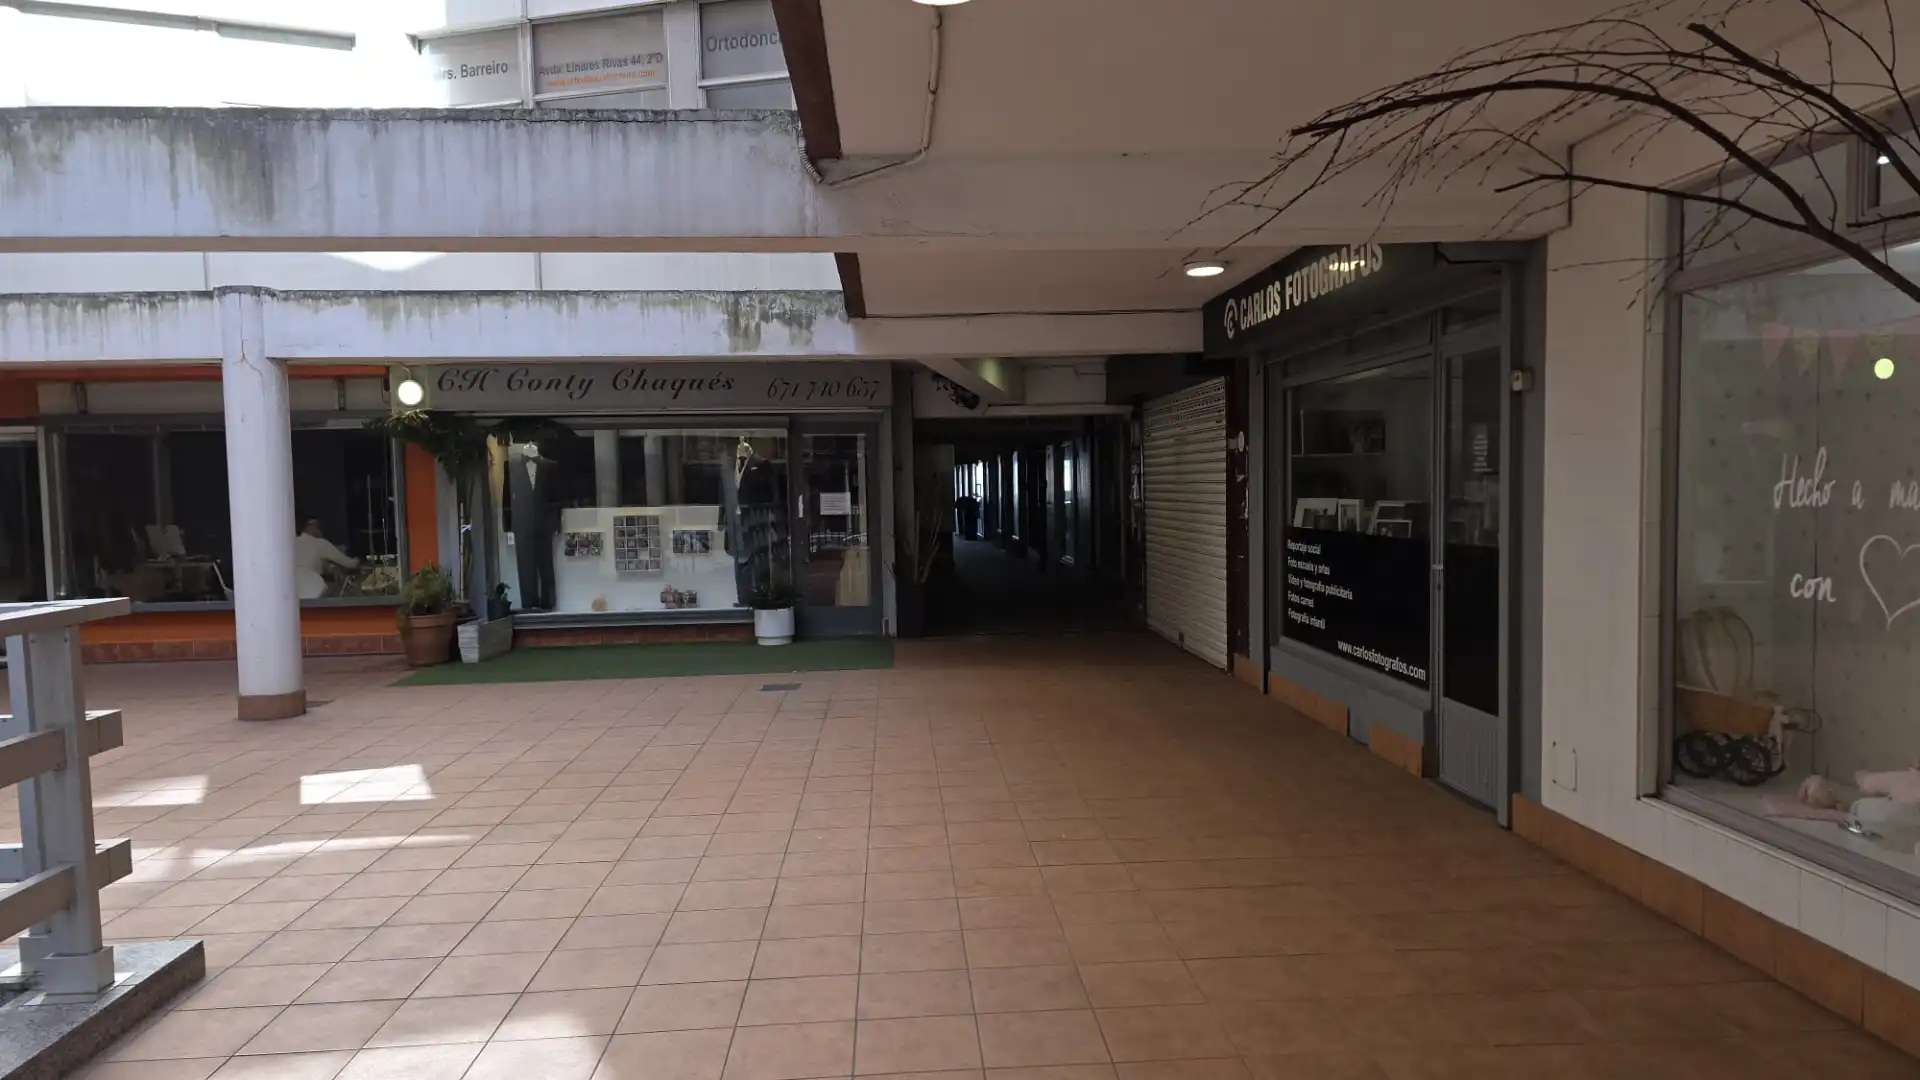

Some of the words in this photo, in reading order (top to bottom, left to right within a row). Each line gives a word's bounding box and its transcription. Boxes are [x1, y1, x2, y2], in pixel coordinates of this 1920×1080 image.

[705, 30, 779, 52] Ortodonc
[460, 60, 508, 78] Barreiro
[566, 60, 600, 73] Linares
[602, 56, 629, 69] Rivas
[1240, 281, 1281, 330] CARLOS
[1285, 243, 1383, 310] FOTOGRAFOS
[506, 367, 596, 400] Conty
[612, 366, 736, 400] Chaqués
[767, 375, 800, 401] 671
[1773, 446, 1836, 511] Hecho
[1851, 479, 1865, 510] a
[1287, 539, 1307, 555] Reportaje
[1308, 543, 1321, 555] social
[1287, 556, 1297, 568] Foto
[1298, 560, 1314, 572] escuela
[1287, 590, 1300, 604] Fotos
[1325, 584, 1353, 600] publicitaria
[1790, 573, 1836, 602] con
[1310, 616, 1326, 630] infantil
[1337, 640, 1426, 681] www.carlosfotografos.com
